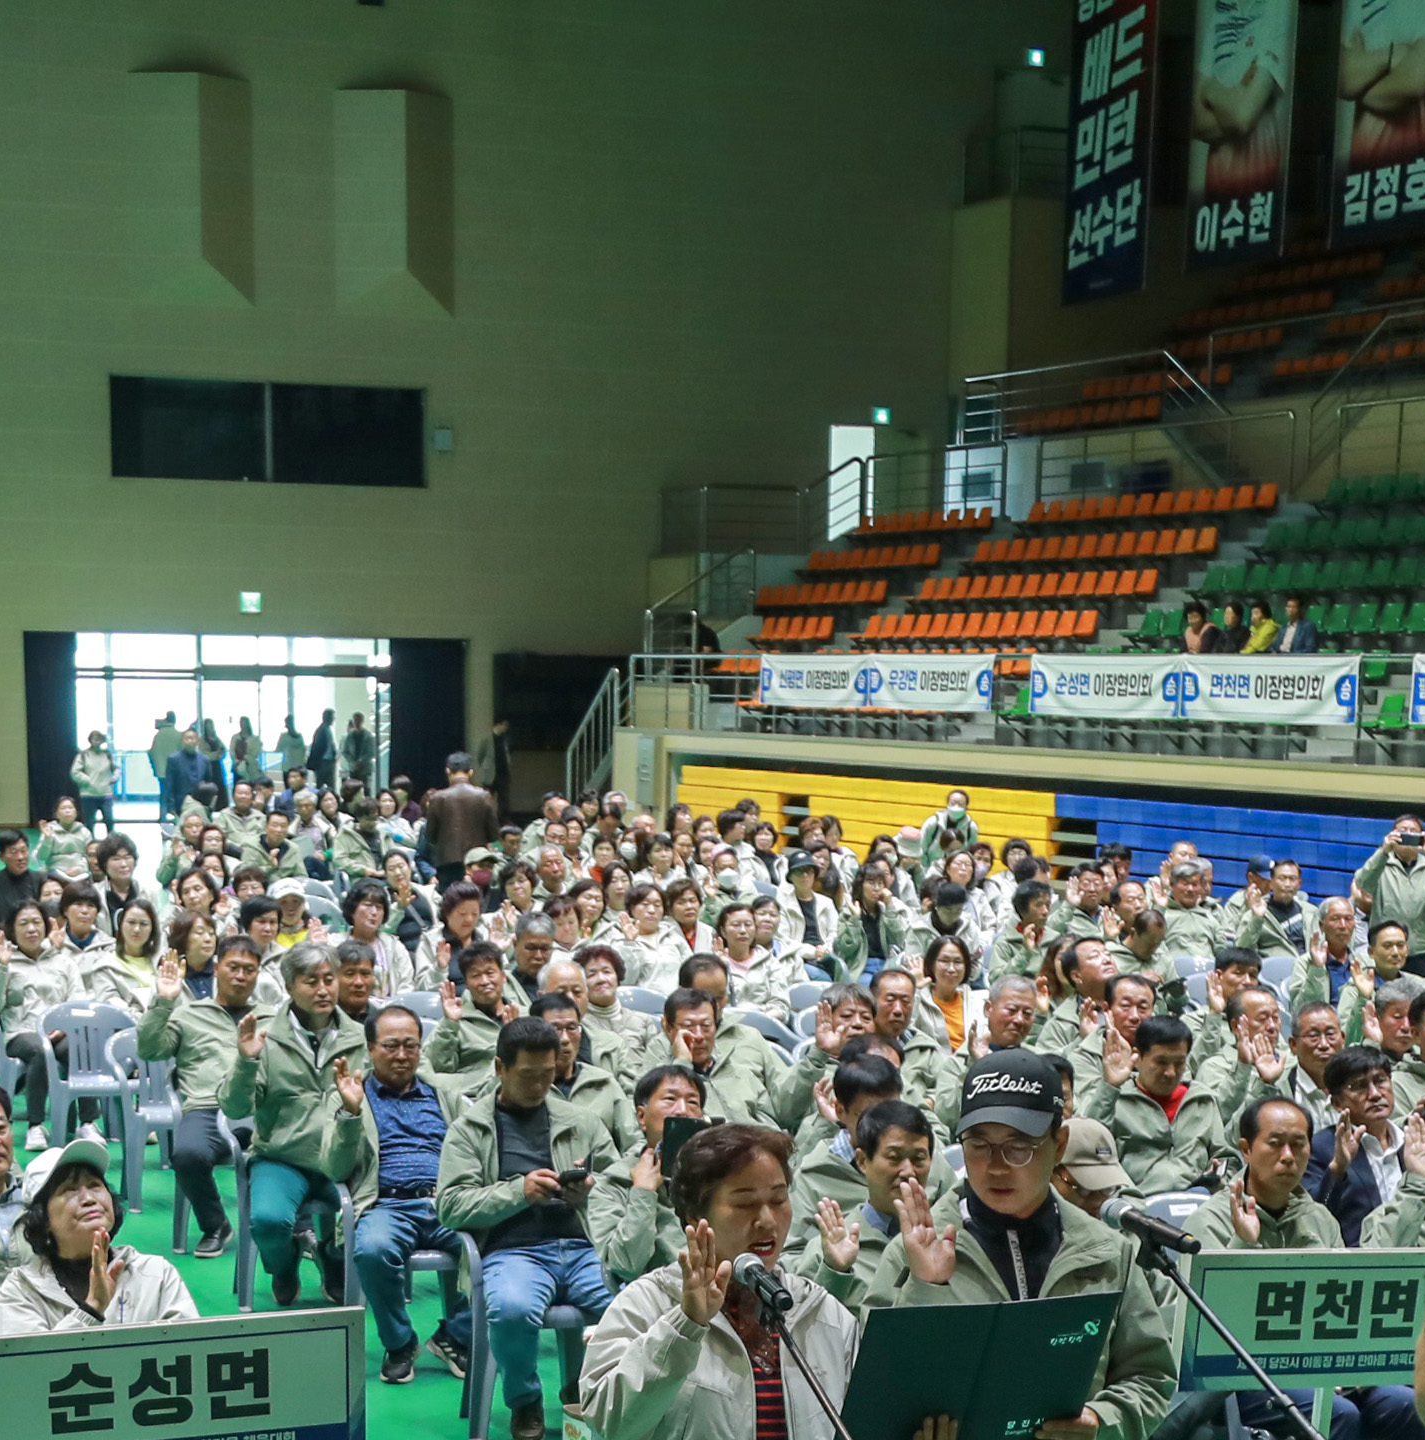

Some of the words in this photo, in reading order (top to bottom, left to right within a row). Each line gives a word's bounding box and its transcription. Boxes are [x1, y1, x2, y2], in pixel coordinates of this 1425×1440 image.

[1080, 4, 1146, 105] 배드
[1074, 90, 1138, 191] 민턴
[1067, 179, 1141, 270] 선수단
[1195, 191, 1273, 252] 이수현
[1055, 672, 1091, 696] 순성면
[1093, 672, 1154, 697] 이장협의회
[1209, 673, 1251, 699] 면천면
[1254, 674, 1325, 700] 이장협의회
[967, 1072, 1043, 1099] Titleist
[1255, 1279, 1419, 1340] 면천면
[48, 1348, 271, 1435] 순성면
[1269, 1356, 1302, 1369] 당진시
[1358, 1353, 1386, 1367] 한마음
